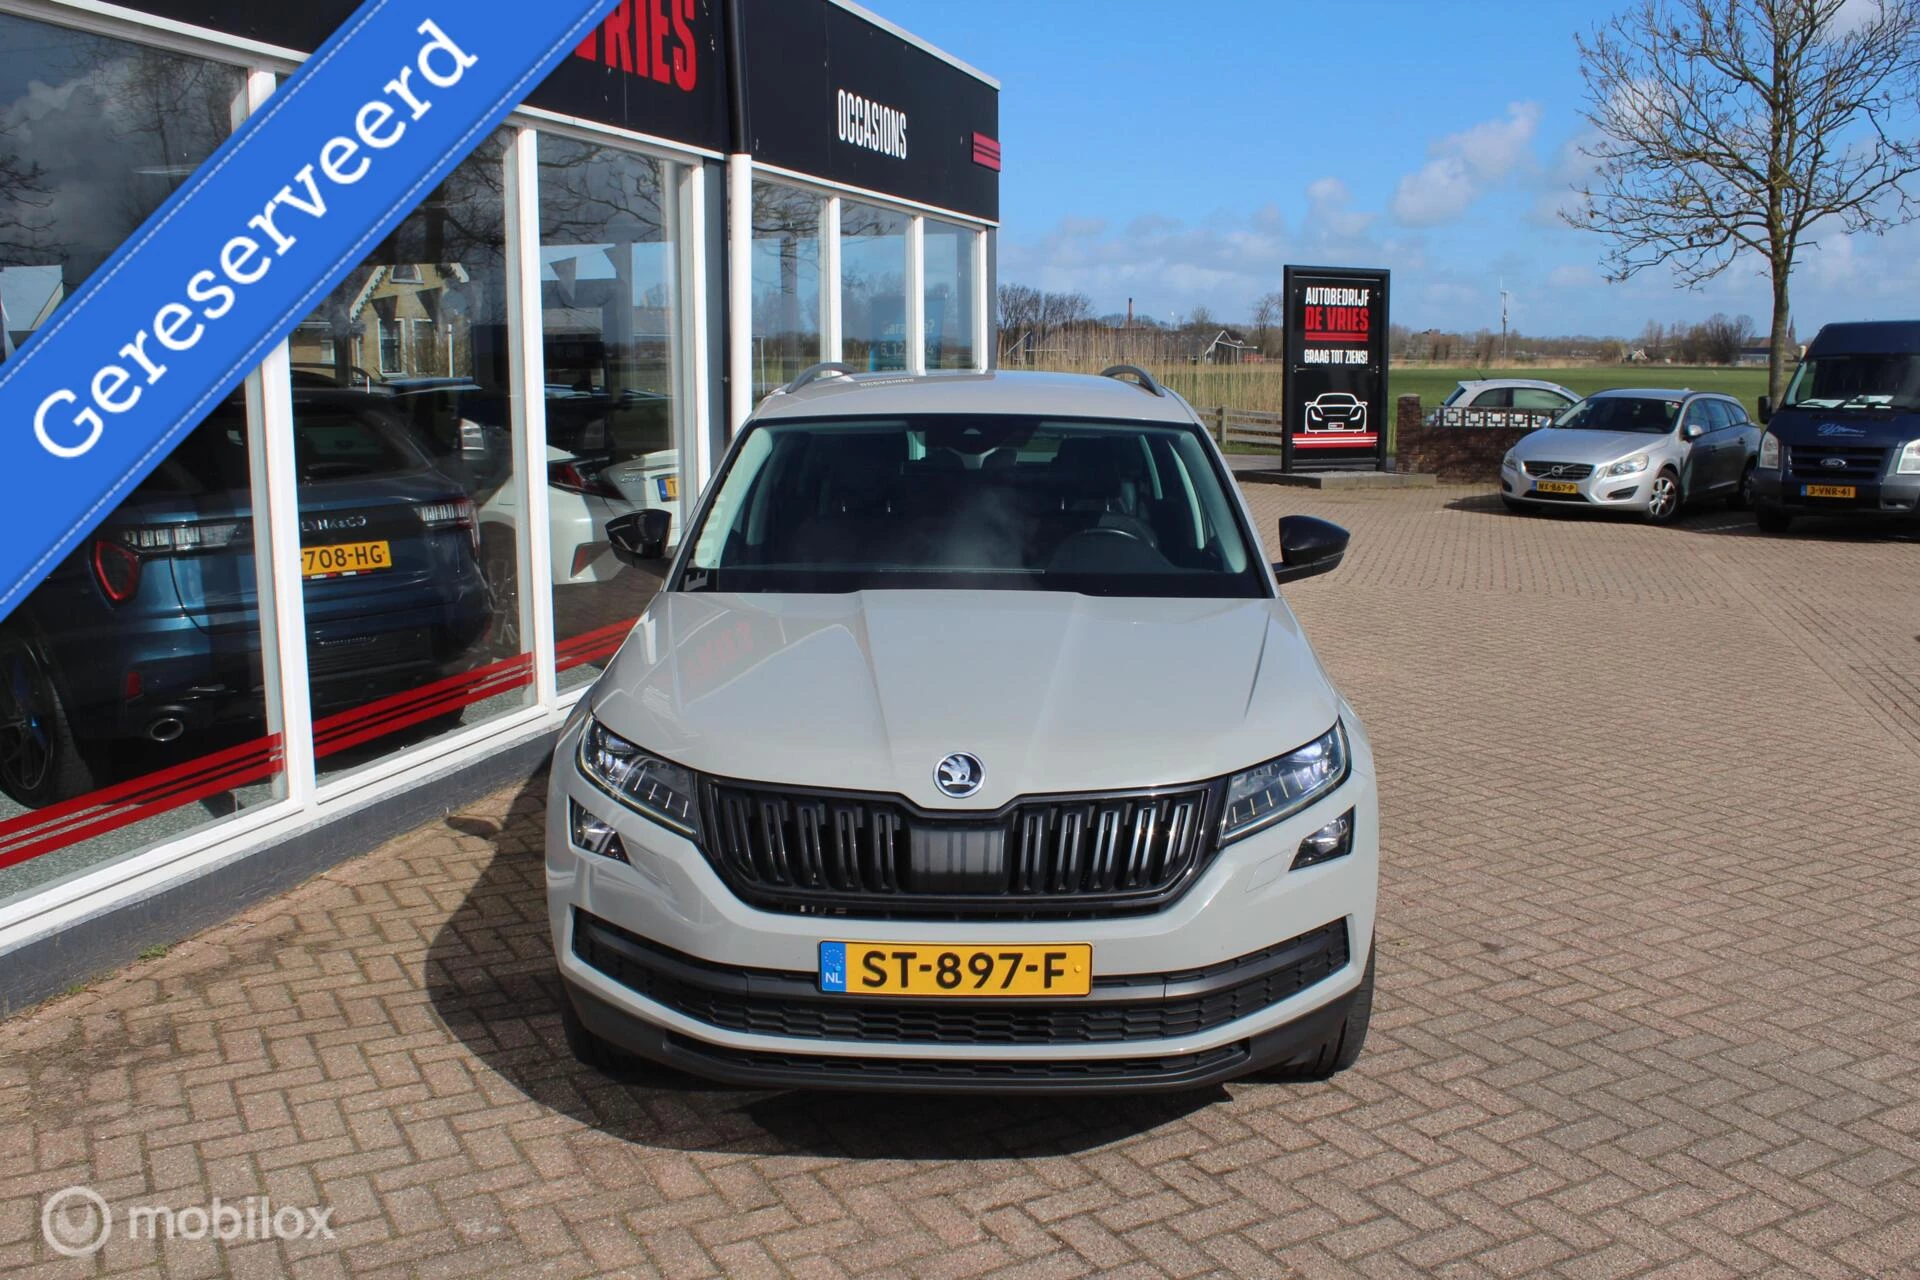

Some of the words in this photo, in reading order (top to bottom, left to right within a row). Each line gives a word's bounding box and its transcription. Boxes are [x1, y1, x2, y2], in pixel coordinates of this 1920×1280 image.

[838, 88, 907, 160] OCCASIONS
[1305, 287, 1370, 306] AUTOBEDRIJF
[1305, 306, 1323, 330] DE
[1327, 307, 1369, 331] VRIES
[1304, 349, 1330, 364] GRAAG
[1330, 349, 1344, 364] TOT
[1345, 350, 1369, 365] ZIENS!
[1810, 486, 1851, 496] 3-VNR-41
[300, 544, 384, 571] -708-HG
[825, 972, 843, 984] NL
[861, 950, 1067, 989] ST-897-F
